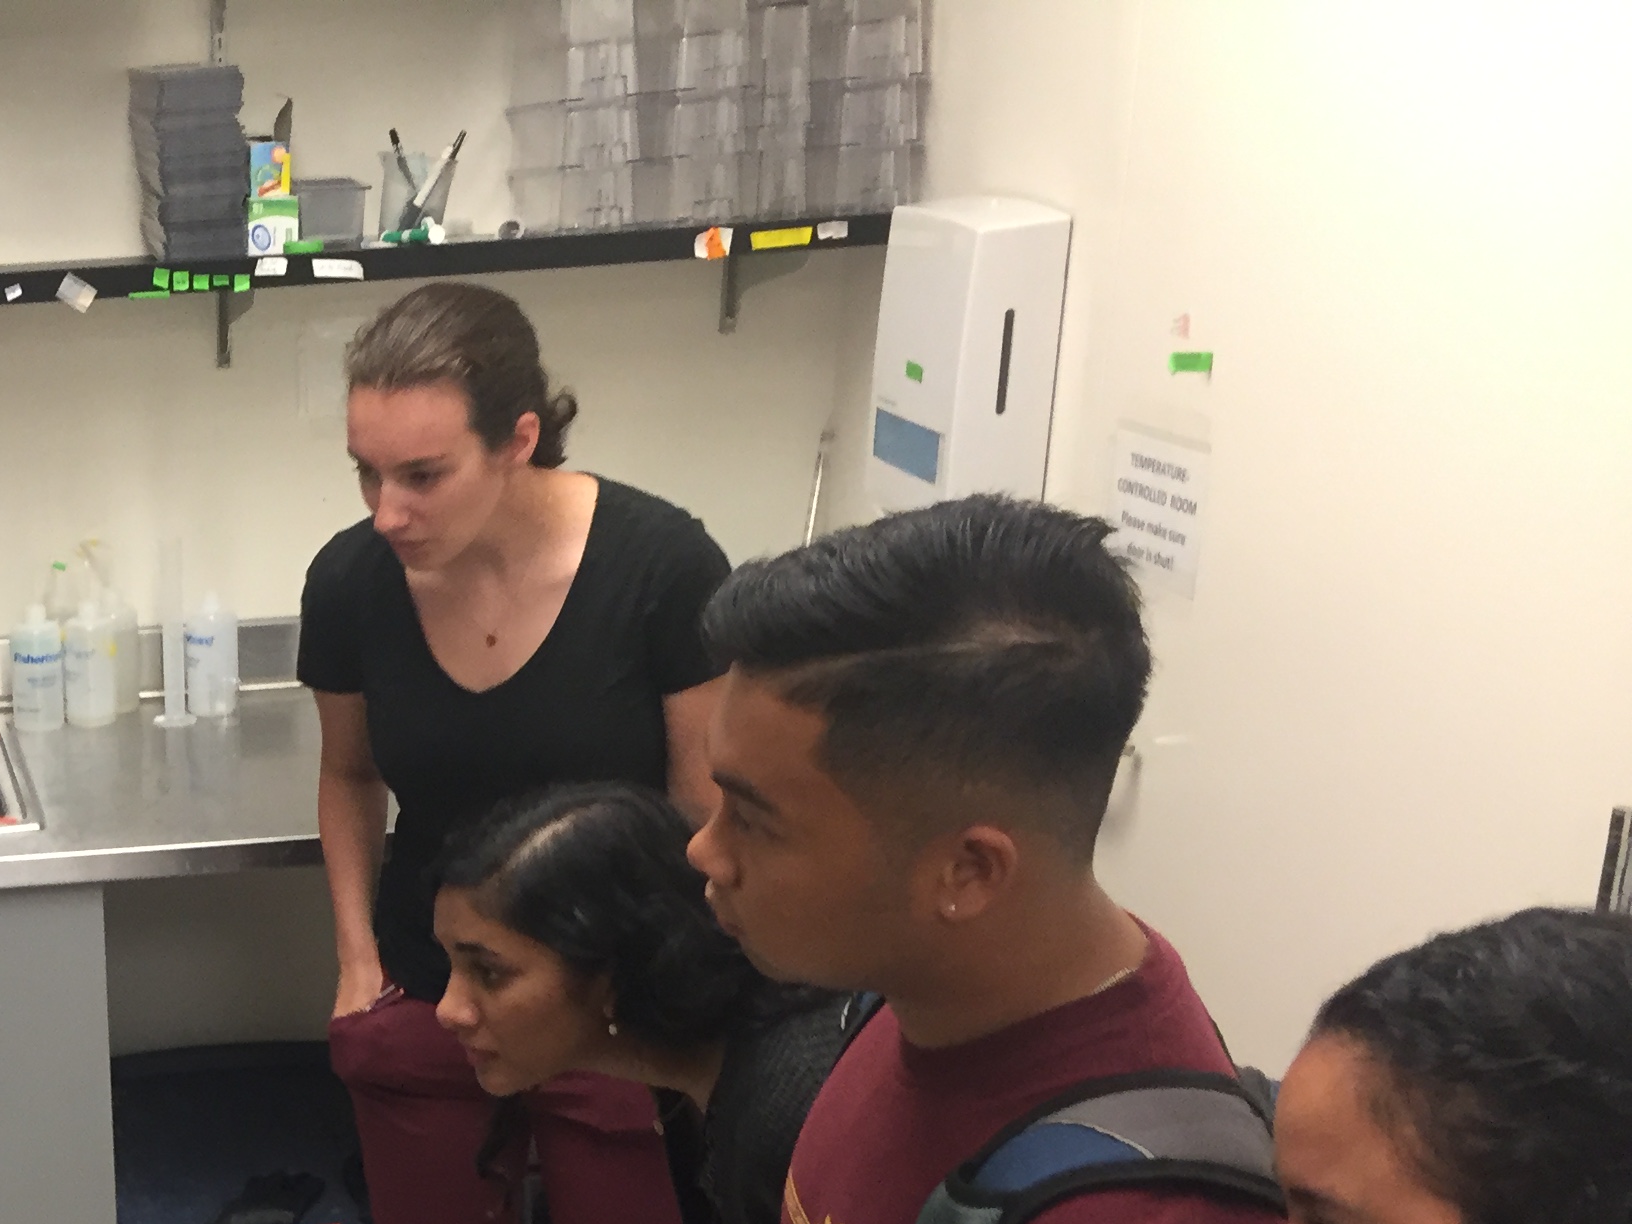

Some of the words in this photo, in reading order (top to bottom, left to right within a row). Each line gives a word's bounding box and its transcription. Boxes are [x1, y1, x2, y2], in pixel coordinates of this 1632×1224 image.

[1117, 477, 1167, 507] CONTROLLED
[1170, 494, 1197, 516] ROOM
[1121, 510, 1145, 531] Please
[1146, 522, 1167, 540] make
[1168, 529, 1186, 546] sure
